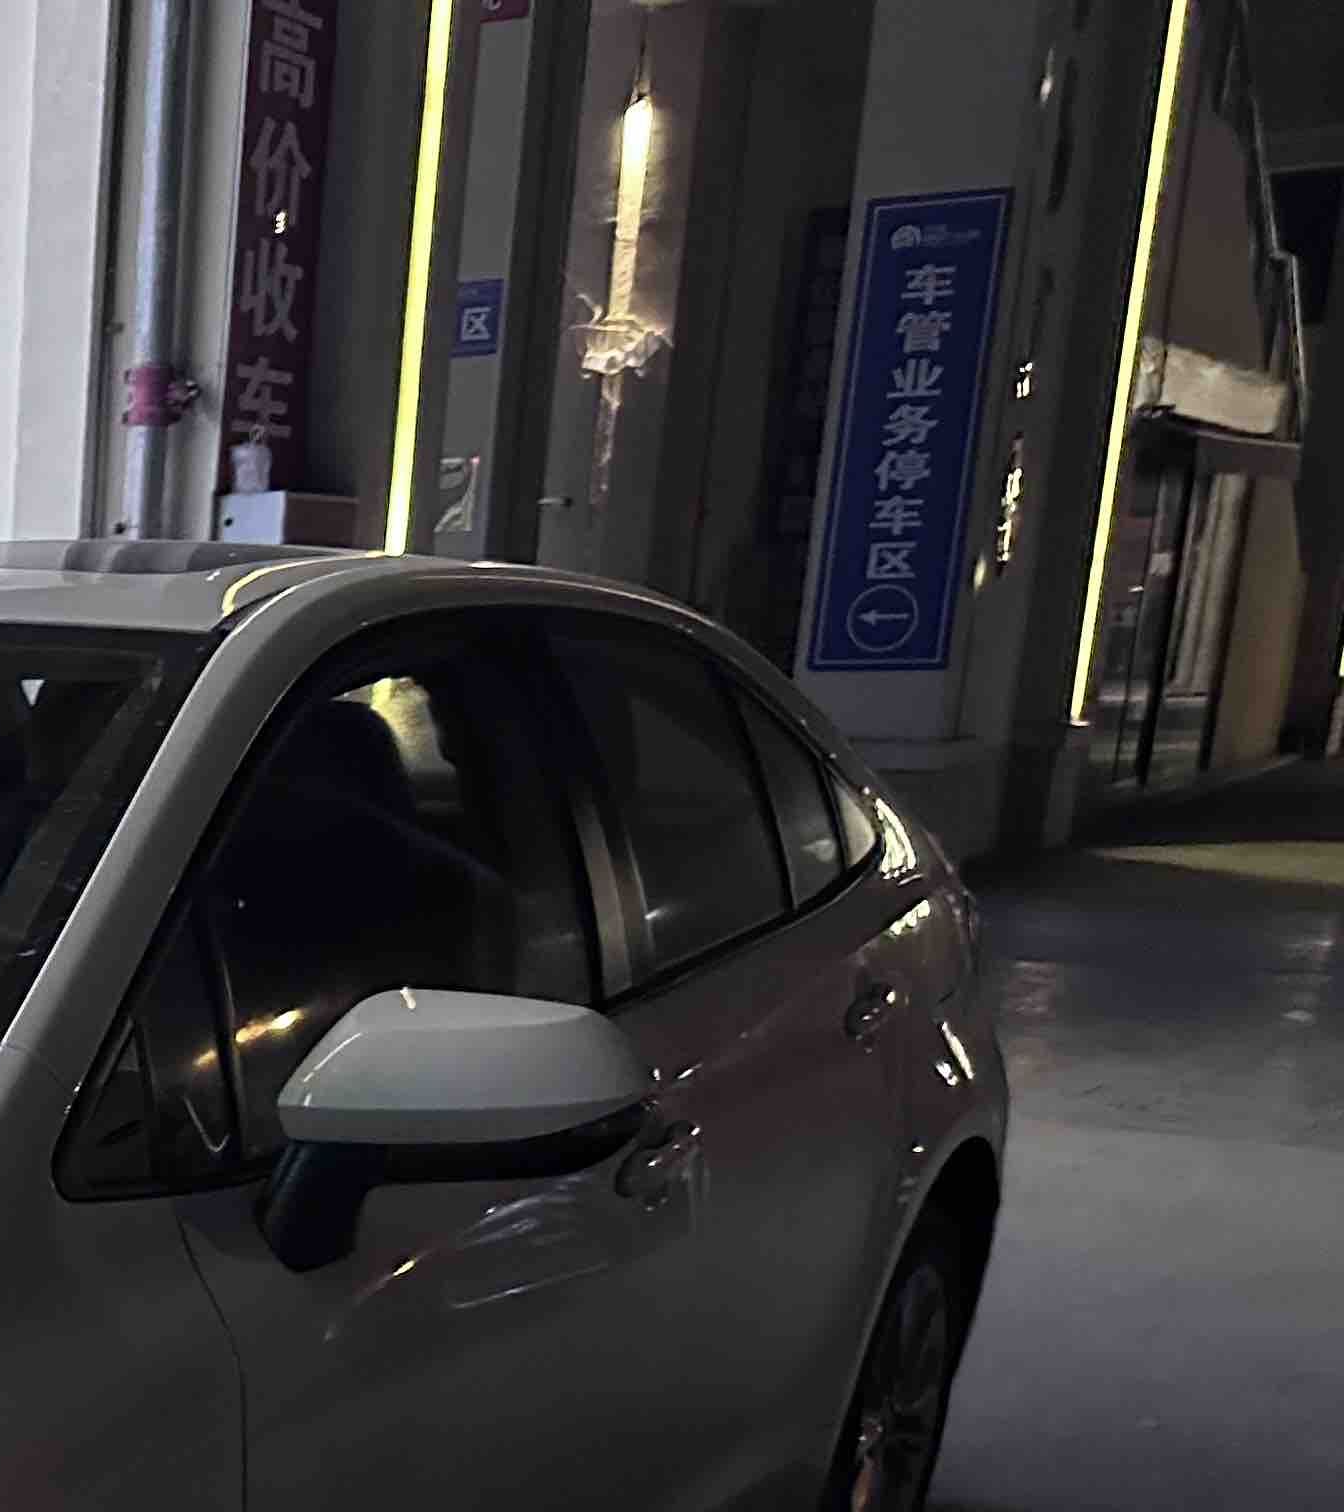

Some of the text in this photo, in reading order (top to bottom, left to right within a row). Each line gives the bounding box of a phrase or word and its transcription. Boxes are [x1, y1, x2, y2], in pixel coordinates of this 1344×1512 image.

[232, 0, 324, 439] 高价收车
[866, 263, 956, 580] 车管业务停车区
